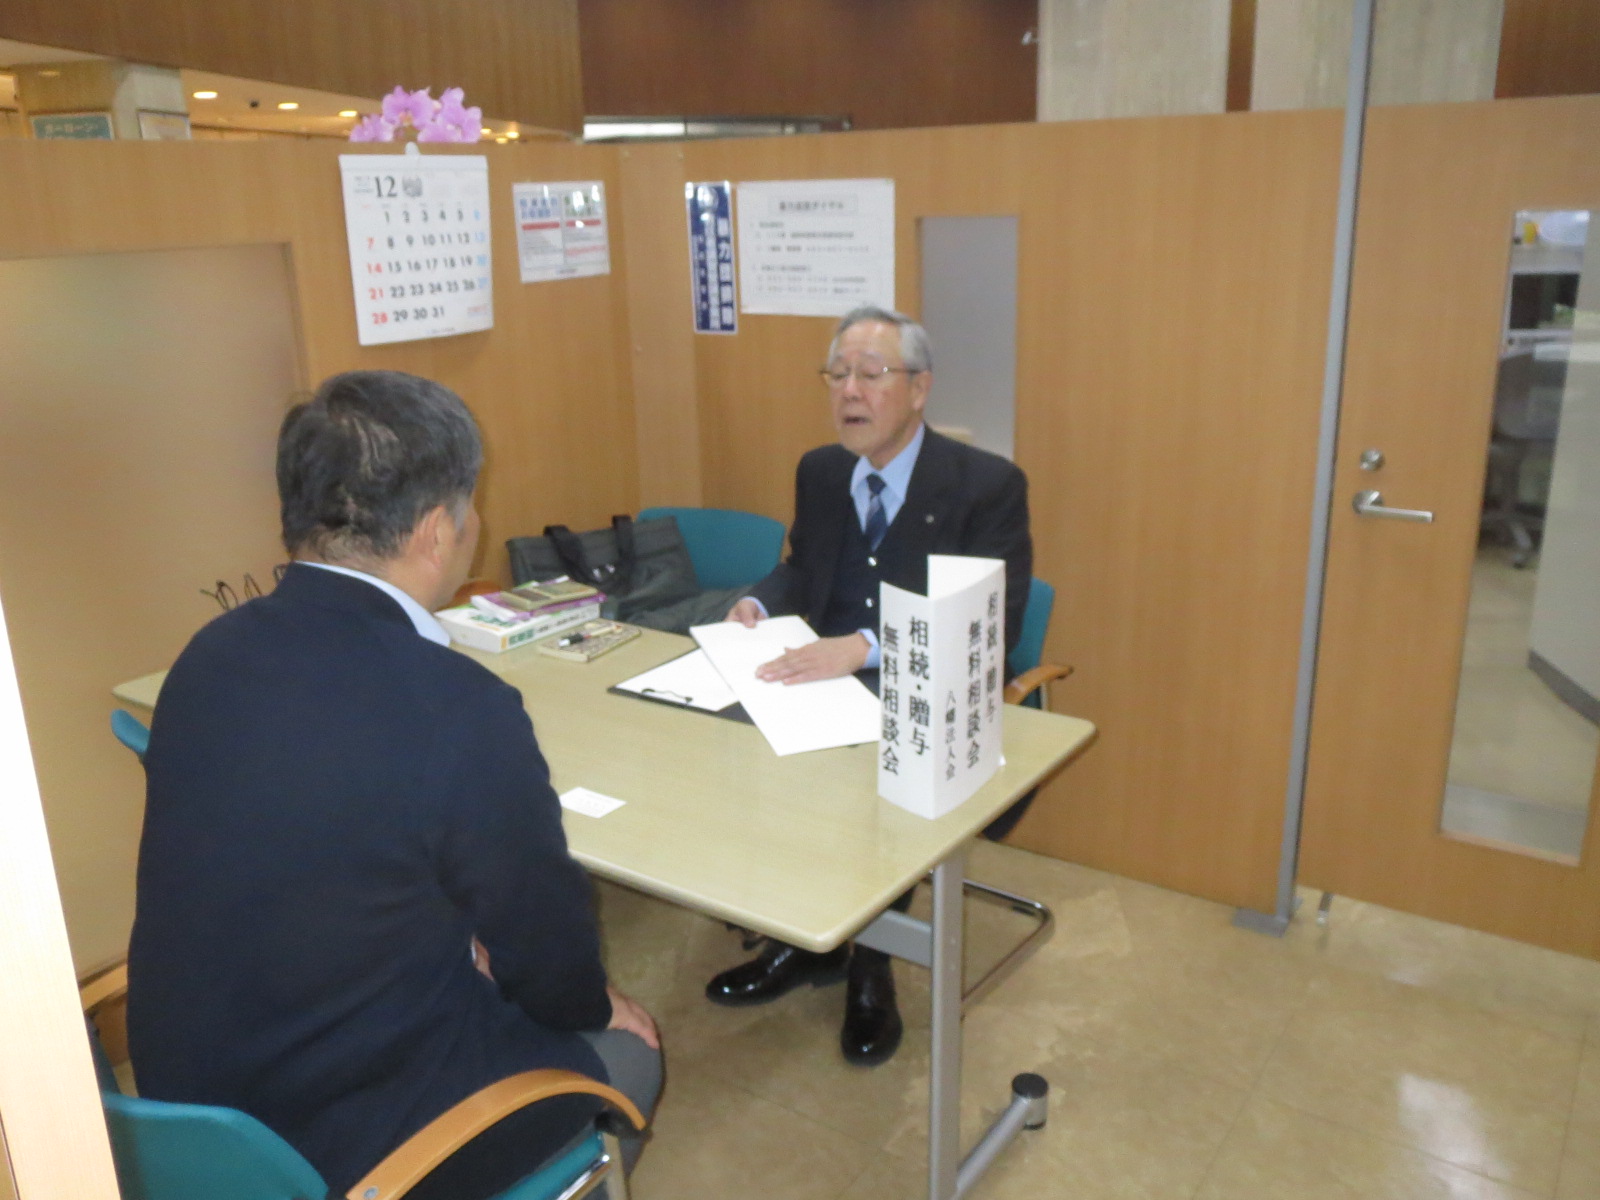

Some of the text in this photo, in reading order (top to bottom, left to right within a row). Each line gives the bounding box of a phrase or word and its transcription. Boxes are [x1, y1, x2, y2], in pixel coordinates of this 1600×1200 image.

[374, 175, 398, 198] 12
[403, 211, 410, 223] 2
[422, 210, 429, 223] 3
[439, 210, 446, 221] 4
[457, 210, 464, 221] 5
[367, 237, 375, 249] 7
[387, 236, 395, 249] 8
[406, 235, 414, 247] 9
[422, 234, 436, 245] 10
[440, 233, 452, 244] 11
[457, 232, 470, 244] 12
[367, 263, 383, 274] 14
[388, 261, 402, 272] 15
[407, 260, 421, 271] 16
[426, 259, 438, 270] 17
[443, 258, 456, 268] 18
[460, 255, 473, 266] 19
[368, 288, 384, 300] 21
[390, 285, 405, 298] 22
[409, 285, 424, 296] 23
[428, 282, 443, 295] 24
[446, 281, 459, 292] 25
[462, 279, 476, 291] 26
[372, 307, 445, 324] 28 29 30 31
[908, 616, 930, 755] 相続・贈与
[968, 618, 981, 769] 無料相談会
[883, 621, 899, 775] 無料相談会
